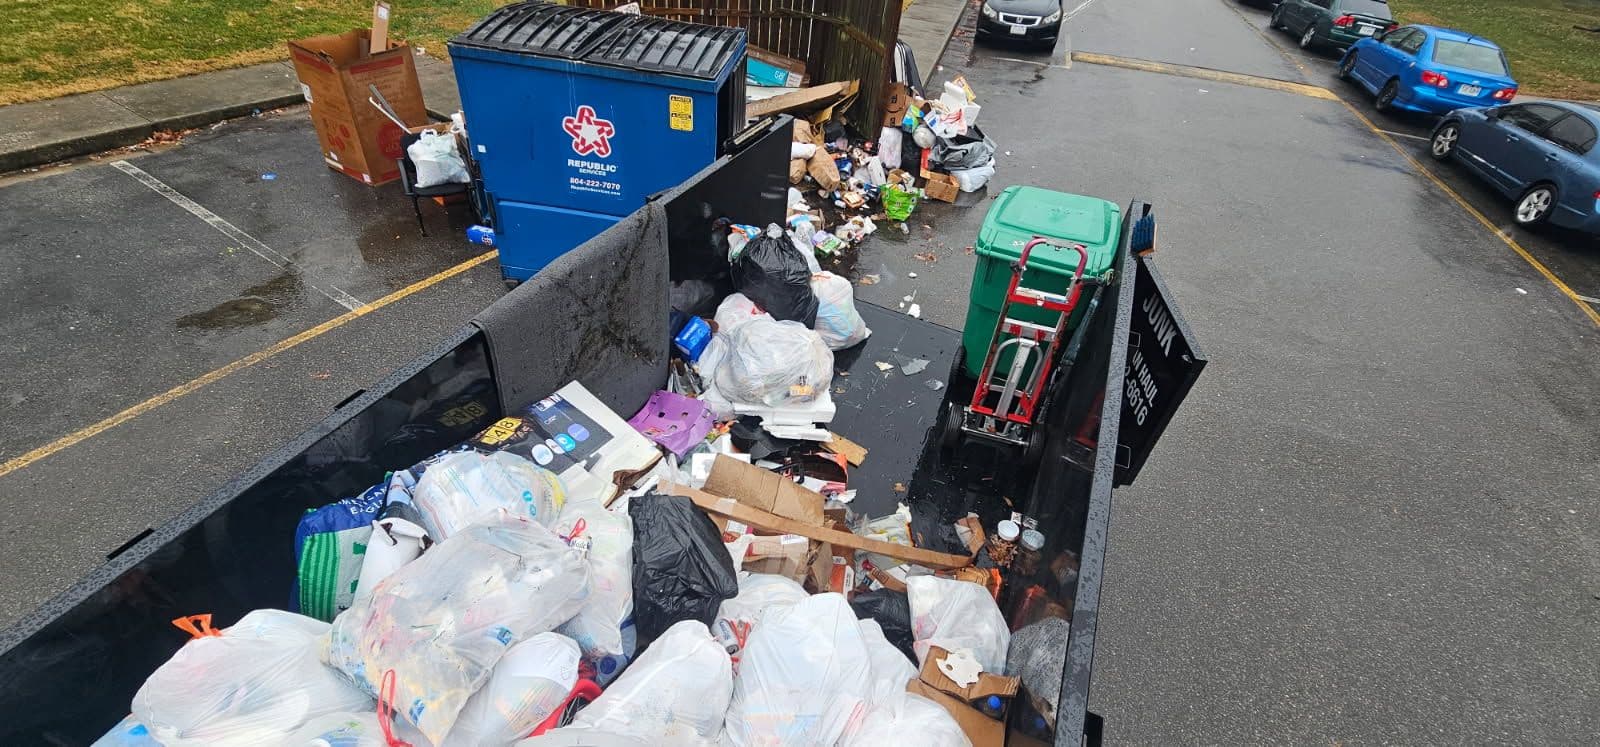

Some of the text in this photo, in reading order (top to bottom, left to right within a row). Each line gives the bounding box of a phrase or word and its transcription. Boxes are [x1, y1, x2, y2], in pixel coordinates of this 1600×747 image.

[567, 158, 617, 173] REPUBLIC
[579, 168, 606, 177] SERVICES
[569, 177, 621, 191] 804-222-7070
[1142, 293, 1177, 357] JUNK
[1138, 365, 1158, 408] HAUL
